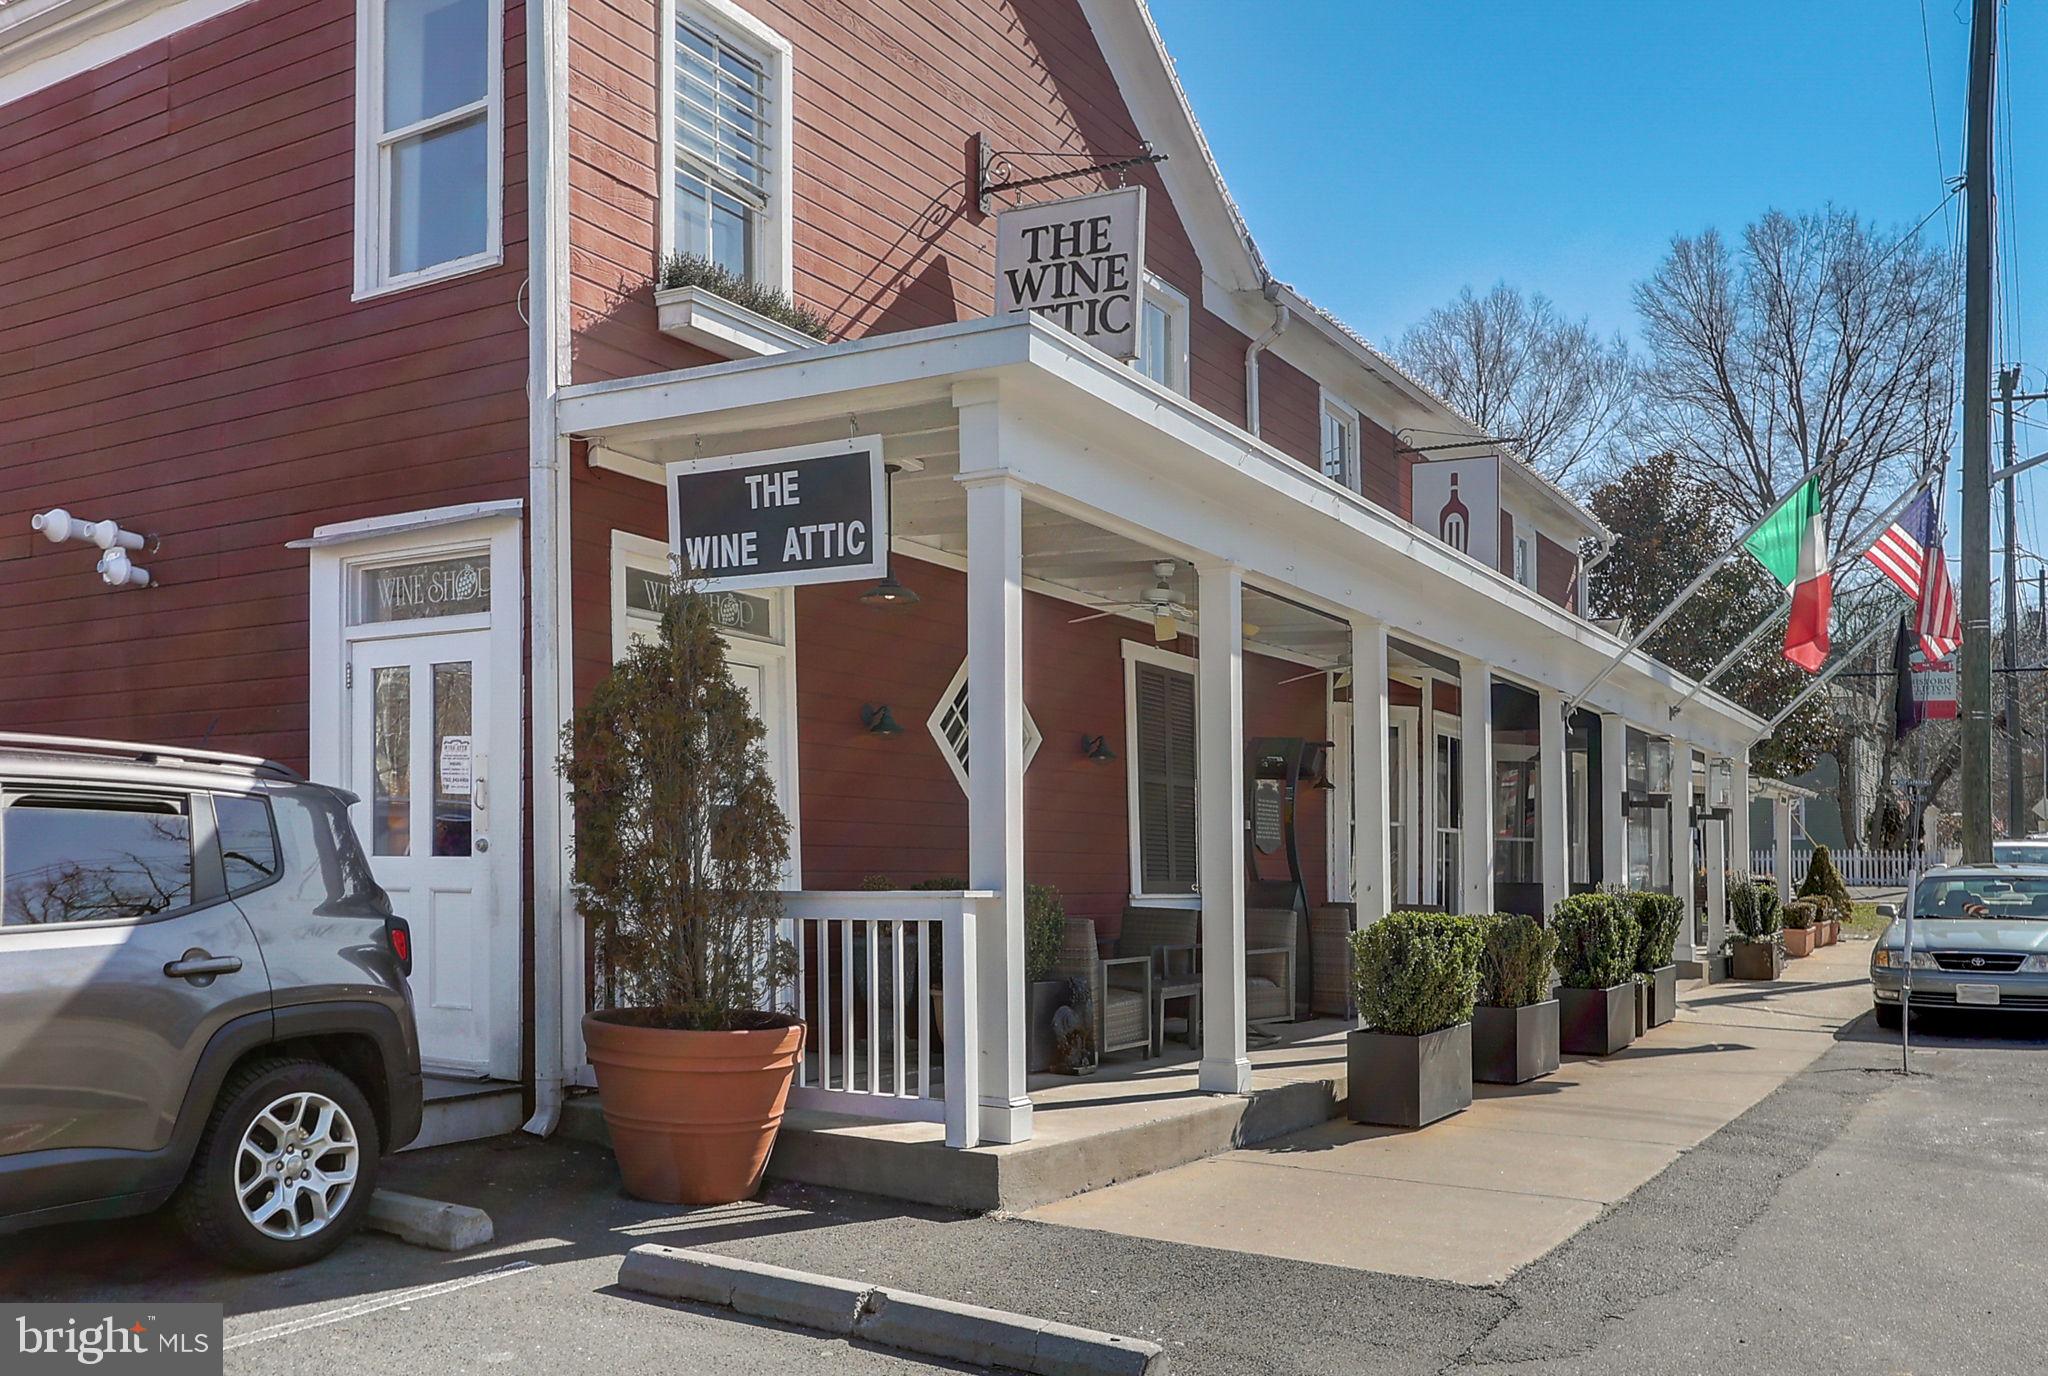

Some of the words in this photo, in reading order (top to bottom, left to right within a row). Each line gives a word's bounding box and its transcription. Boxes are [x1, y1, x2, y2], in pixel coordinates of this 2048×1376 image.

[1021, 215, 1112, 263] THE
[1004, 253, 1129, 305] WINE
[1009, 294, 1131, 336] TIC
[745, 470, 800, 510] THE
[685, 531, 758, 570] WINE
[782, 520, 865, 563] ATTIC
[378, 574, 424, 608] WINE
[428, 565, 490, 602] SHOP
[703, 592, 753, 628] HOP
